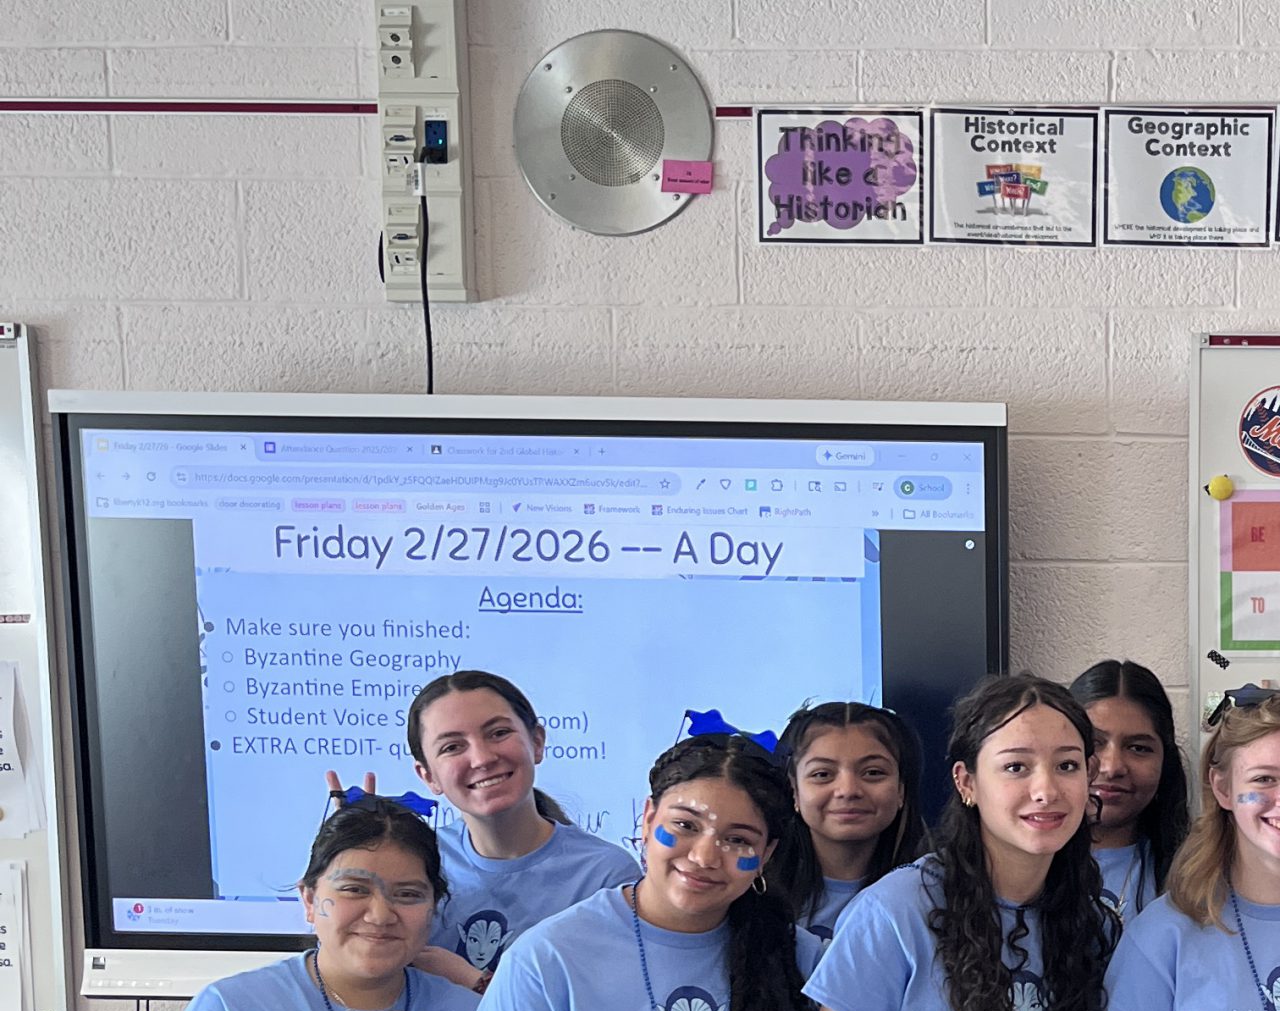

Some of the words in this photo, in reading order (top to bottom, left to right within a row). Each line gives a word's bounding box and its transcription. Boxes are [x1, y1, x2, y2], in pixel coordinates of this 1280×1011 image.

[964, 116, 1065, 136] Historical
[1127, 117, 1250, 140] Geographic
[779, 126, 900, 158] Thinking
[970, 135, 1057, 154] Context
[1145, 138, 1232, 157] Context
[802, 160, 852, 186] like
[775, 194, 907, 221] Historian
[1251, 527, 1265, 543] BE
[275, 524, 393, 570] Friday
[404, 524, 610, 563] 2/27/2026
[673, 531, 698, 564] A
[710, 532, 783, 576] Day
[478, 586, 583, 614] Agenda:
[1251, 597, 1265, 614] TO
[227, 617, 282, 637] Make
[289, 621, 332, 637] sure
[339, 622, 376, 640] you
[383, 619, 471, 639] finished:
[245, 649, 343, 673] Byzantine
[350, 651, 461, 672] Geography
[246, 678, 345, 703] Byzantine
[352, 679, 422, 700] Empire
[247, 708, 327, 726] Student
[333, 708, 396, 726] Voice
[233, 737, 297, 755] EXTRA
[304, 738, 382, 756] CREDIT-
